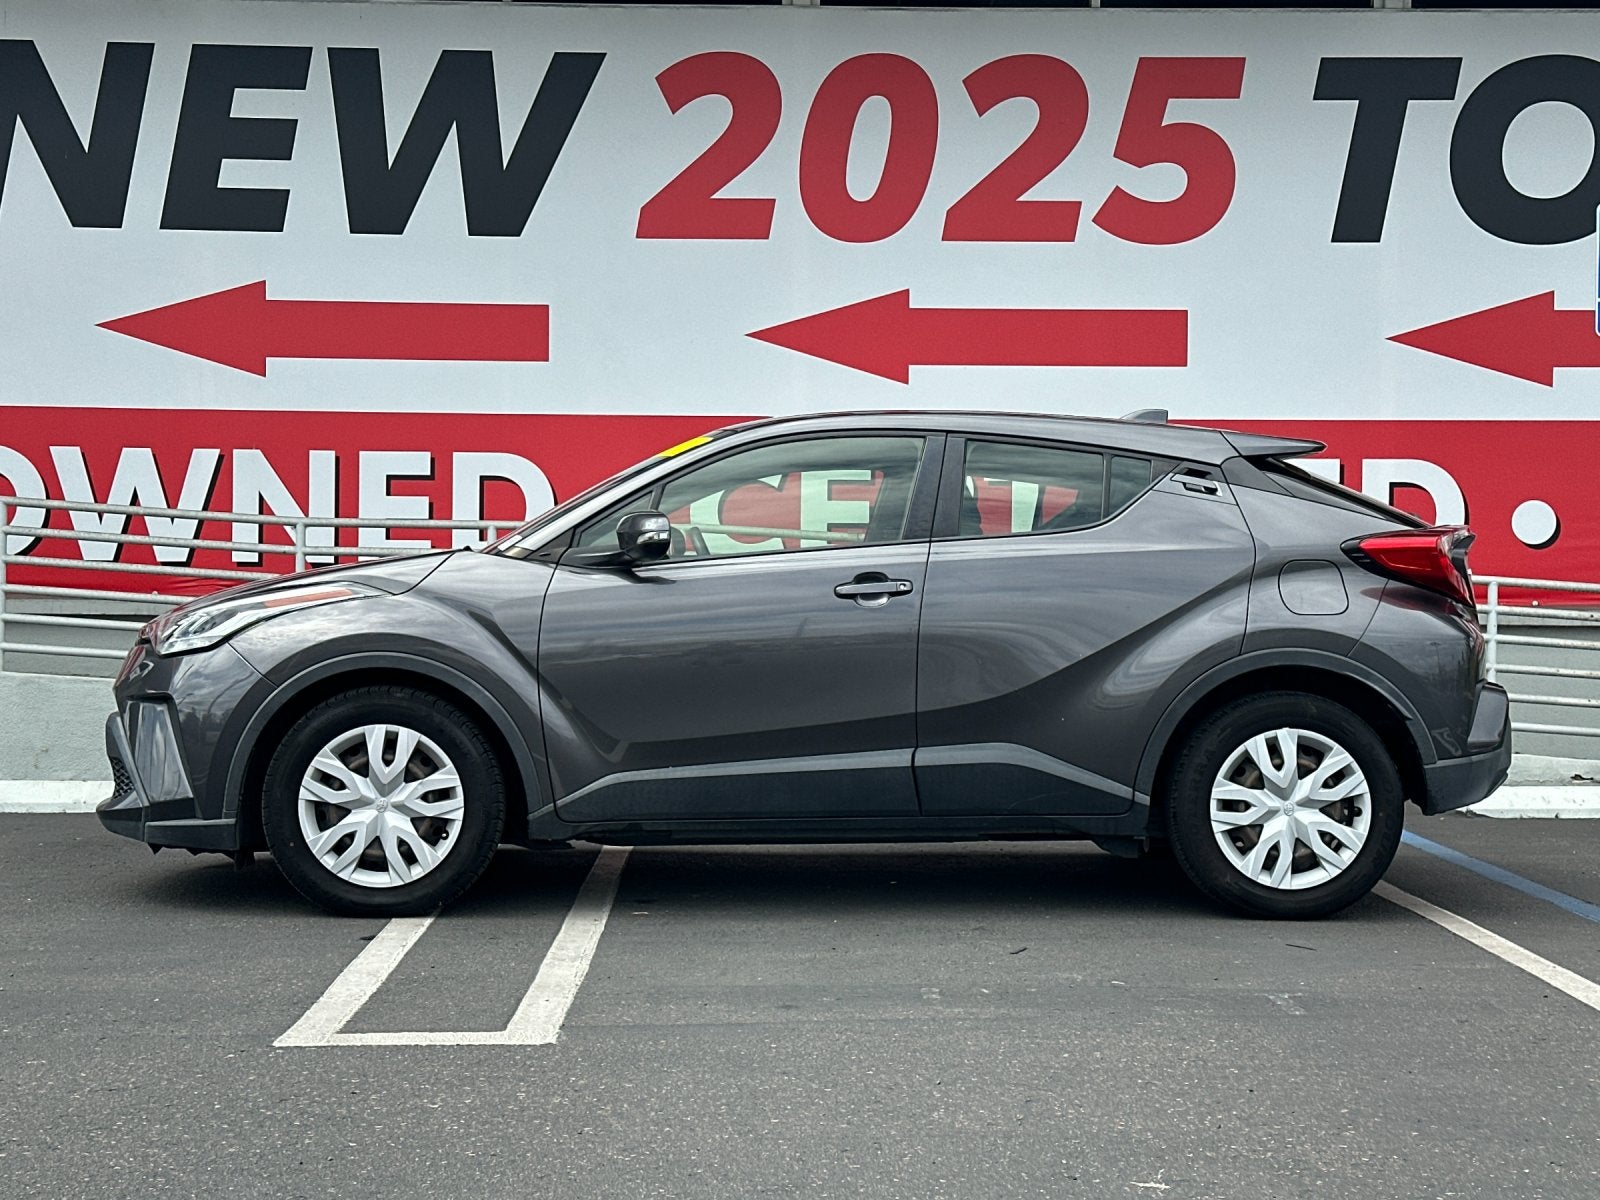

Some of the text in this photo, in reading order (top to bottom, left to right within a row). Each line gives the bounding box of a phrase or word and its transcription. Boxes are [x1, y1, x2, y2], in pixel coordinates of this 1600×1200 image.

[0, 39, 1600, 245] NEW 2025 TO
